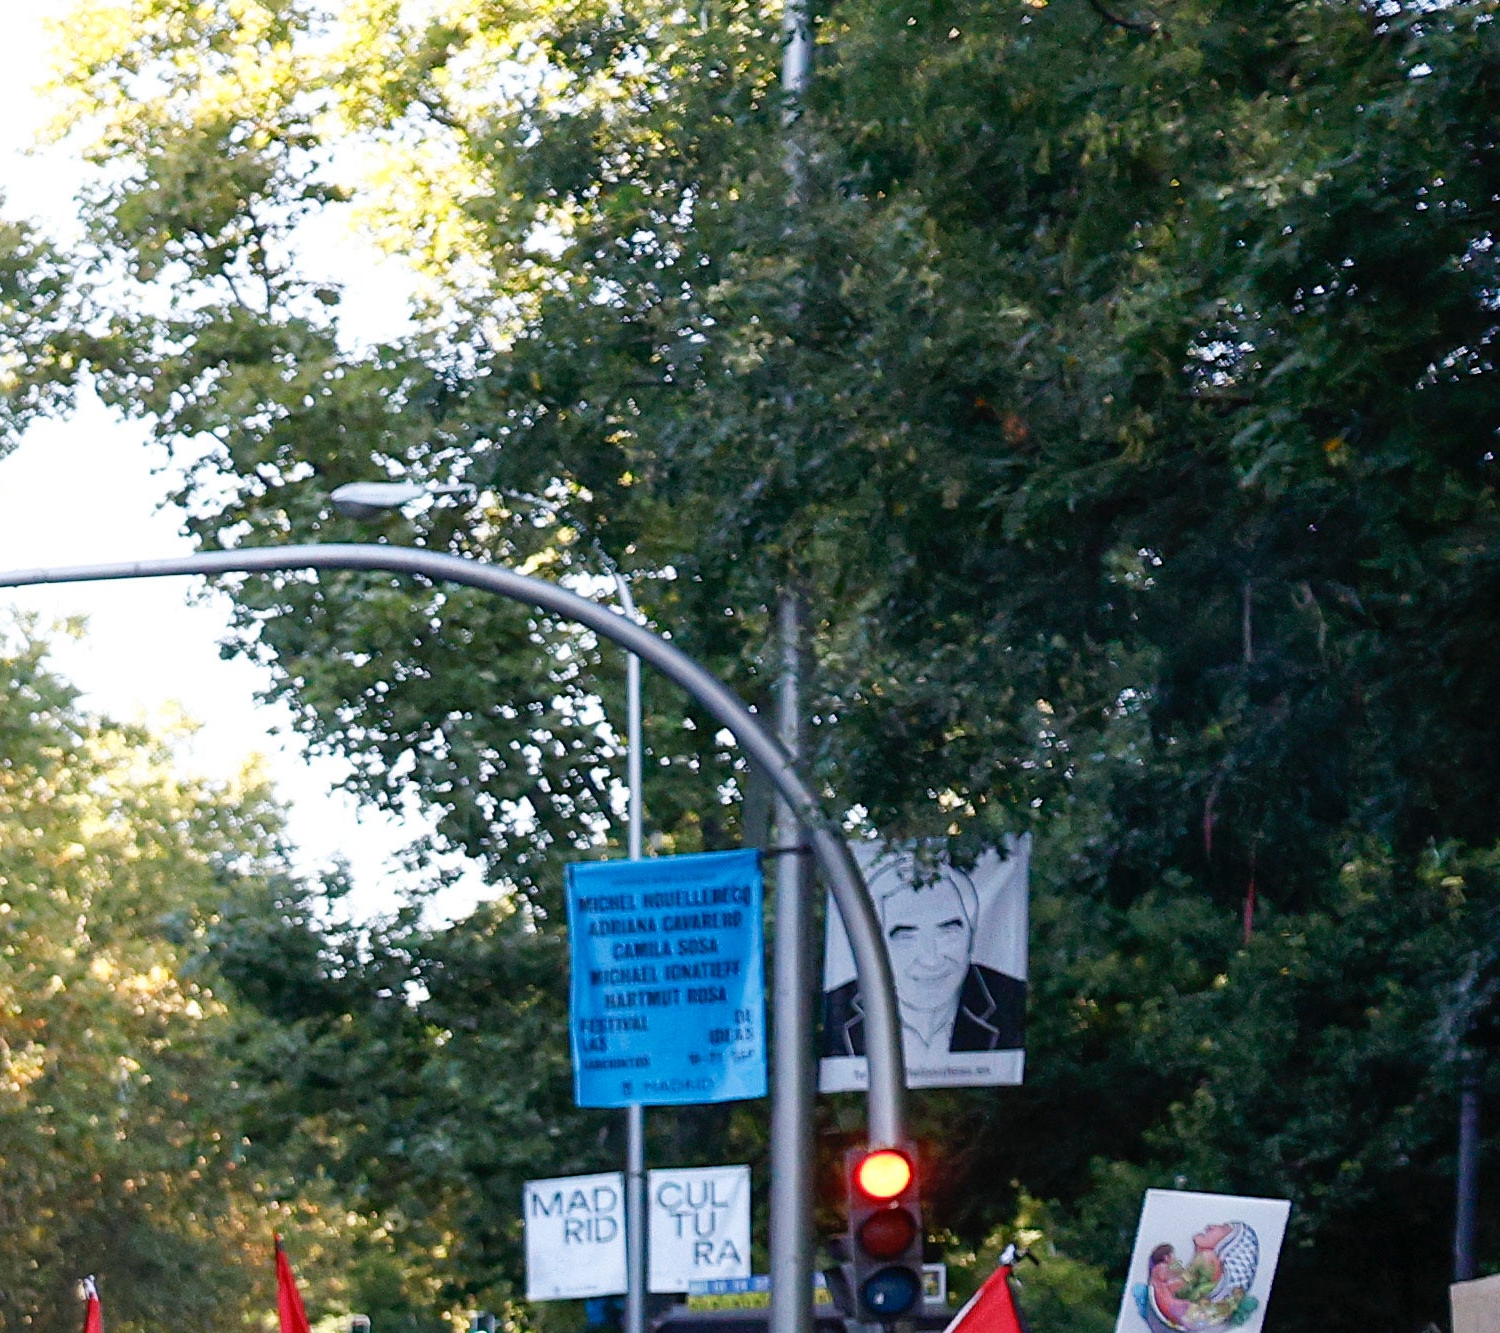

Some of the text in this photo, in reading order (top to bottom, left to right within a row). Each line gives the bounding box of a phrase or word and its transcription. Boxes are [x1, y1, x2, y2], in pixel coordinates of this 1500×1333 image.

[589, 917, 657, 936] ADRIANA
[612, 938, 719, 961] CAMILA SOSA
[590, 968, 658, 986] MICHAEL
[605, 985, 728, 1010] HARTMUT ROSA
[531, 1186, 617, 1216] MAD
[656, 1180, 729, 1209] CUL
[564, 1214, 618, 1245] RID
[673, 1213, 716, 1238] TU
[693, 1241, 741, 1266] RA
